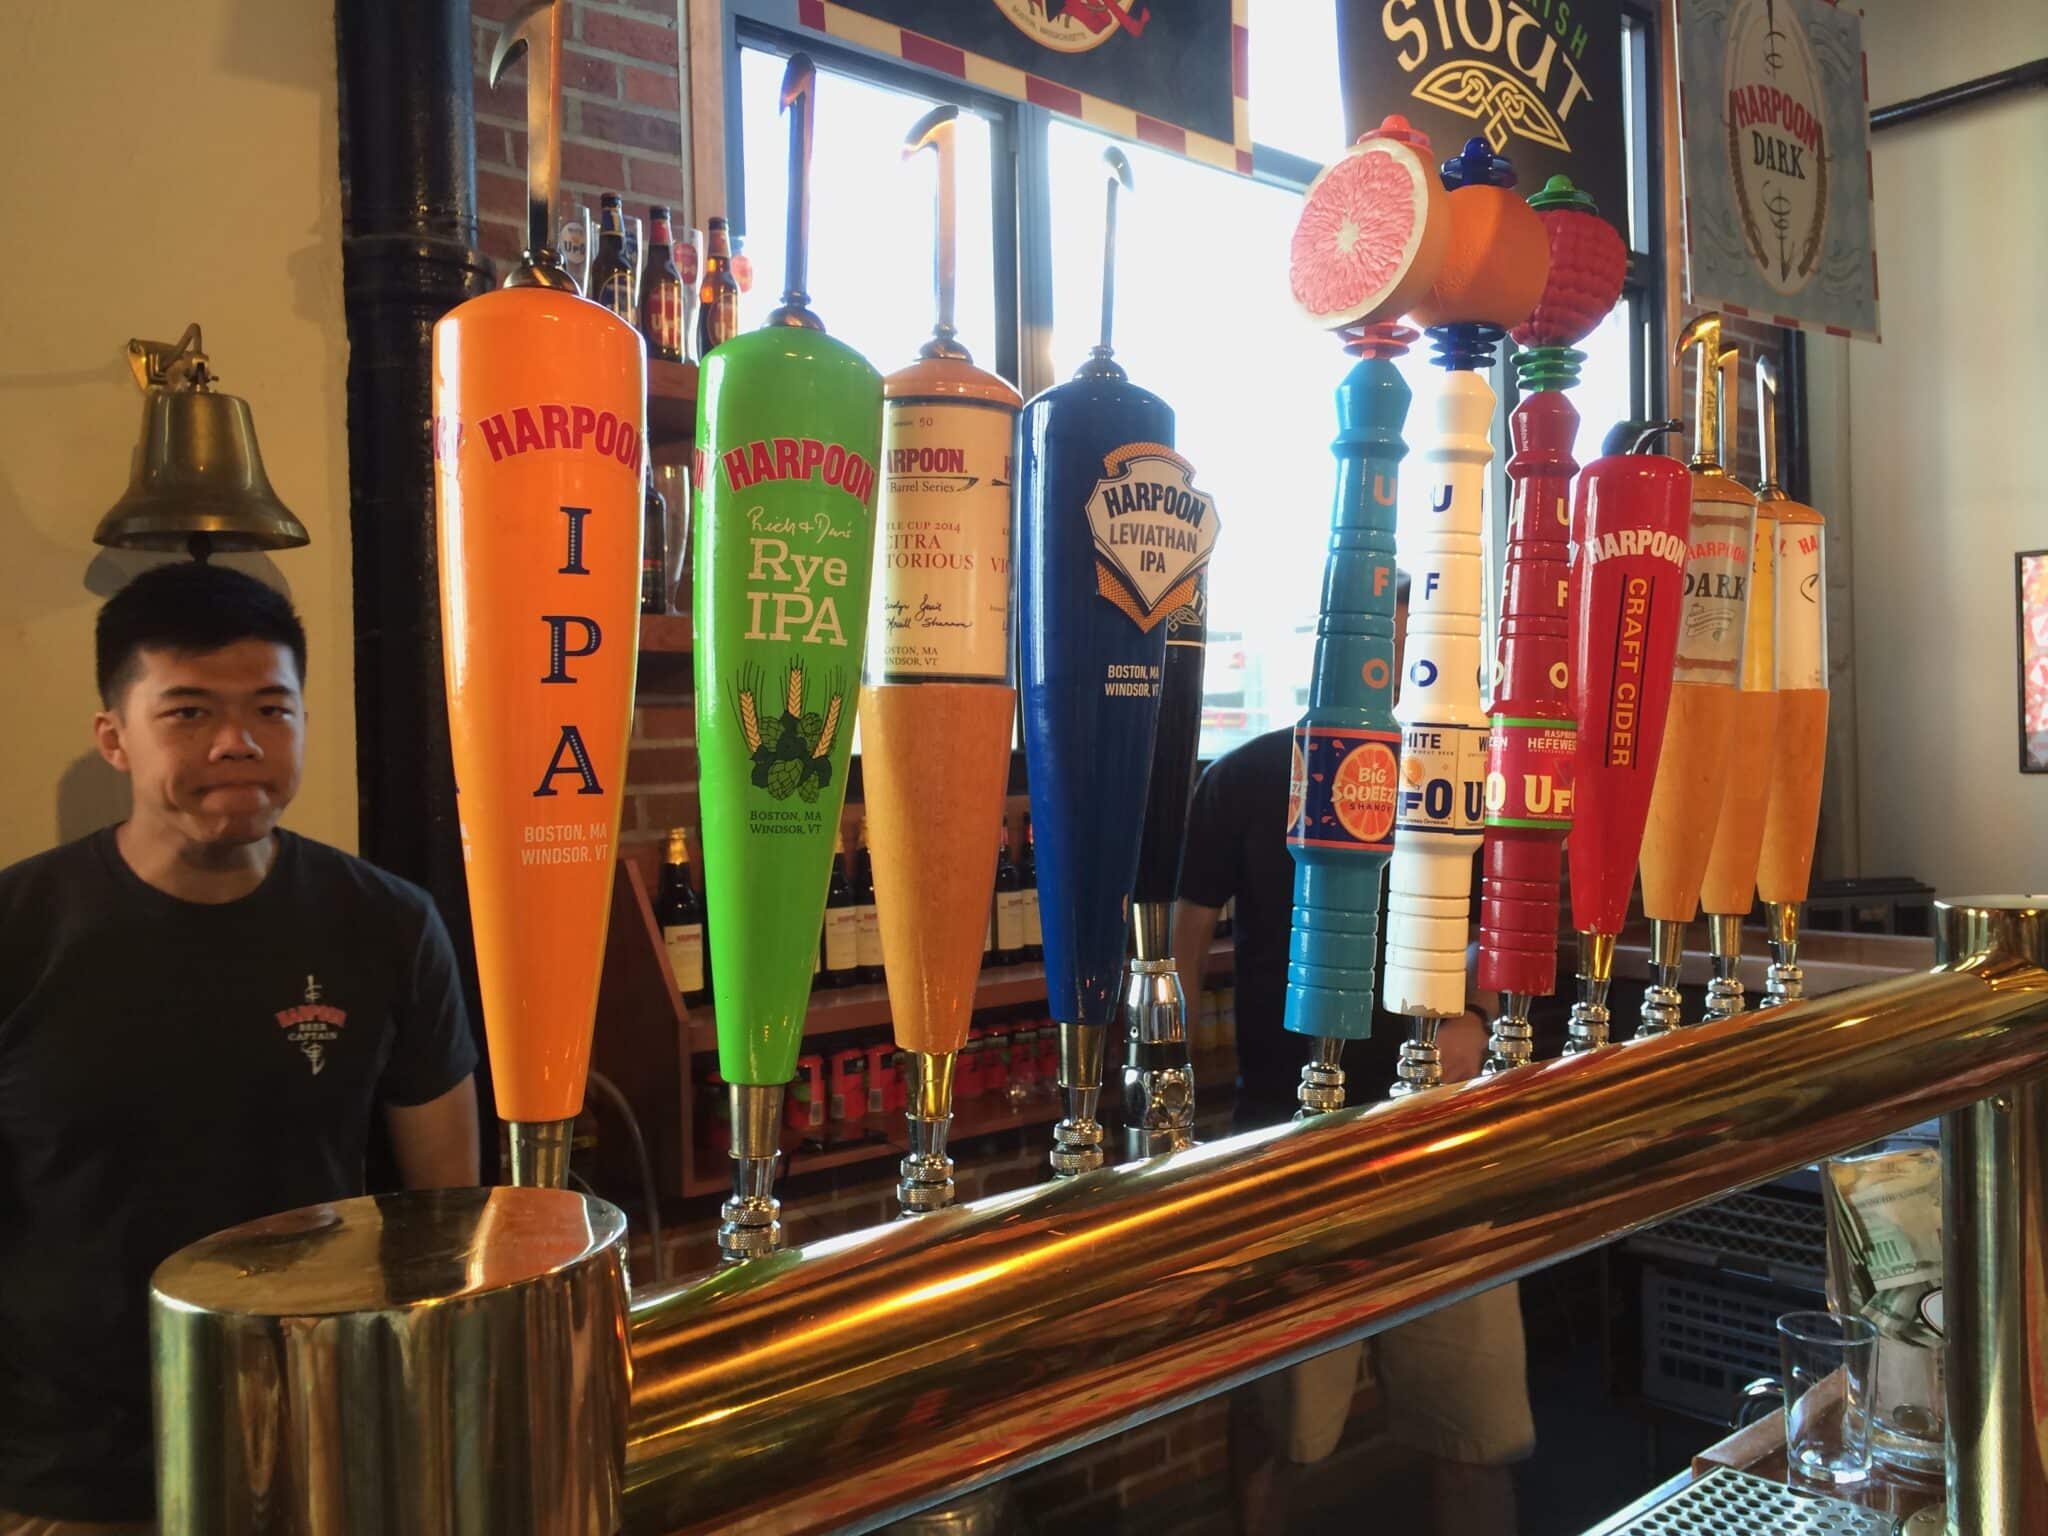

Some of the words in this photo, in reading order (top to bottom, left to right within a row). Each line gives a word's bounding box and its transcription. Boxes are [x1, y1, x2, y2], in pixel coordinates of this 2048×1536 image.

[1734, 83, 1817, 153] HARPOON
[1752, 129, 1806, 180] DARK
[723, 438, 874, 505] HARPOON
[921, 481, 954, 492] Series
[1103, 482, 1206, 532] HARPOON
[907, 521, 930, 530] CUP
[935, 522, 961, 534] 2014
[1110, 523, 1197, 554] LEVIATHAN
[1586, 530, 1687, 568] HARPOON
[748, 537, 848, 592] Rye
[1140, 550, 1166, 573] IPA
[744, 591, 848, 646] IPA
[1620, 577, 1648, 674] CRAFT
[921, 646, 938, 656] MA
[924, 657, 938, 666] VT
[1107, 664, 1149, 681] BOSTON,
[1104, 682, 1151, 698] WINDSOR,
[1612, 682, 1636, 766] CIDER
[804, 810, 822, 821] MA
[589, 823, 608, 839] MA
[808, 823, 822, 833] VT
[595, 844, 608, 861] VT
